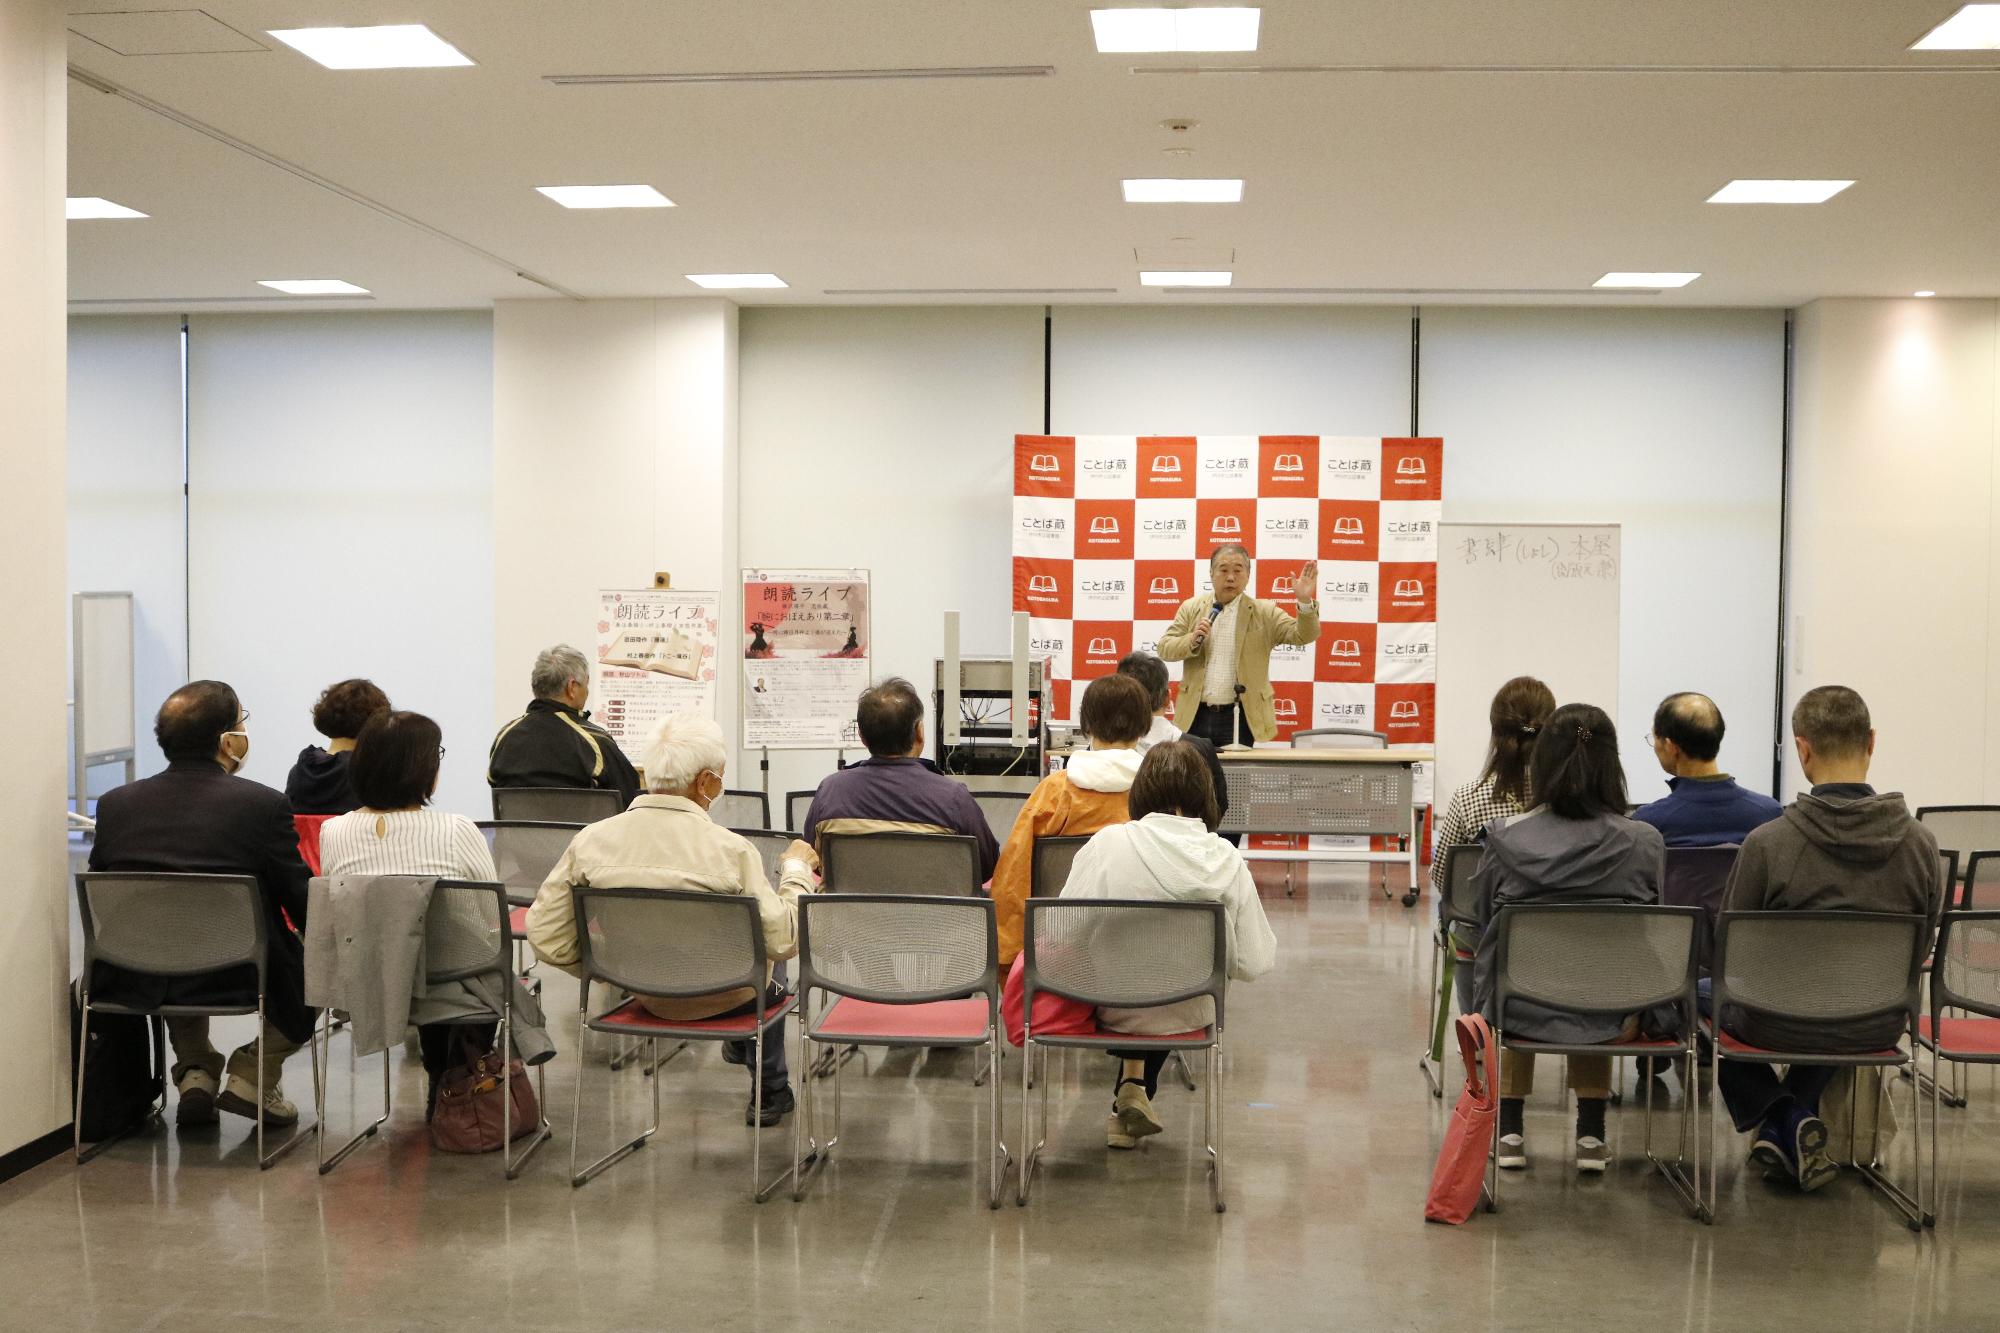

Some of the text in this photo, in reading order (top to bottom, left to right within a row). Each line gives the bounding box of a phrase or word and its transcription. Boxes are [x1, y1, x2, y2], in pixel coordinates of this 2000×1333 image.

[1083, 459, 1127, 470] ことば蔵
[1205, 458, 1248, 470] ことば蔵
[1328, 459, 1372, 471] ことば蔵
[1022, 518, 1065, 530] ことば蔵
[1144, 519, 1186, 530] ことば蔵
[1266, 519, 1309, 530] ことば蔵
[1388, 521, 1431, 532] ことば蔵
[1082, 580, 1126, 592] ことば蔵
[1326, 582, 1369, 594] ことば蔵
[763, 586, 852, 602] 朗読ライブ
[617, 604, 702, 620] 朗読ライブ
[1385, 643, 1429, 654] ことば蔵
[1322, 704, 1366, 716] ことば蔵
